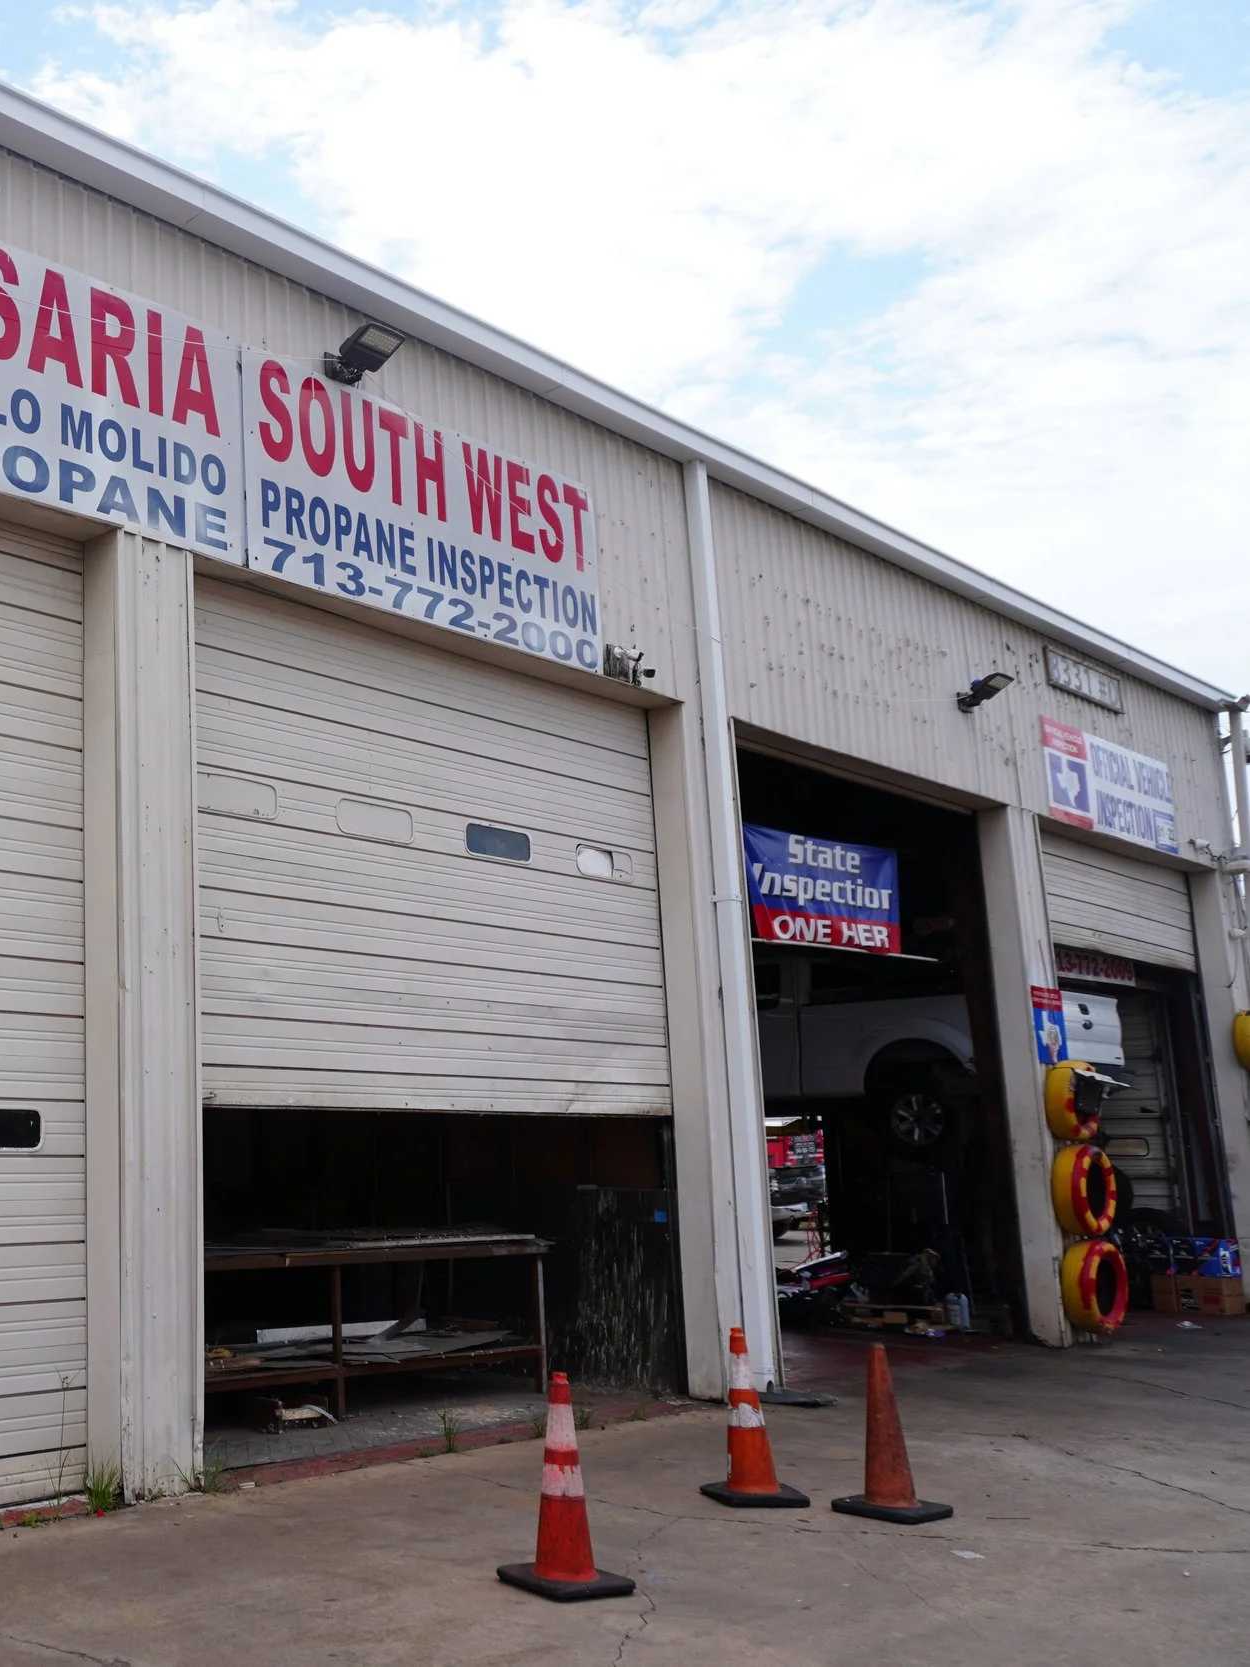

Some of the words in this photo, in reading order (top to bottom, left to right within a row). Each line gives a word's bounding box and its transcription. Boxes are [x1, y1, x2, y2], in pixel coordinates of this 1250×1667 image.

[60, 403, 227, 496] MOLIDO
[258, 359, 448, 523] SOUTH
[462, 441, 589, 572] WEST
[260, 478, 417, 577] PROPANE
[427, 537, 598, 636] INSPECTION
[263, 536, 599, 669] 713-772-2000
[1090, 742, 1134, 791] OFFICIAL
[1133, 759, 1173, 803] VEHICLE
[1096, 789, 1154, 841] INSPECTION
[788, 834, 861, 874] State
